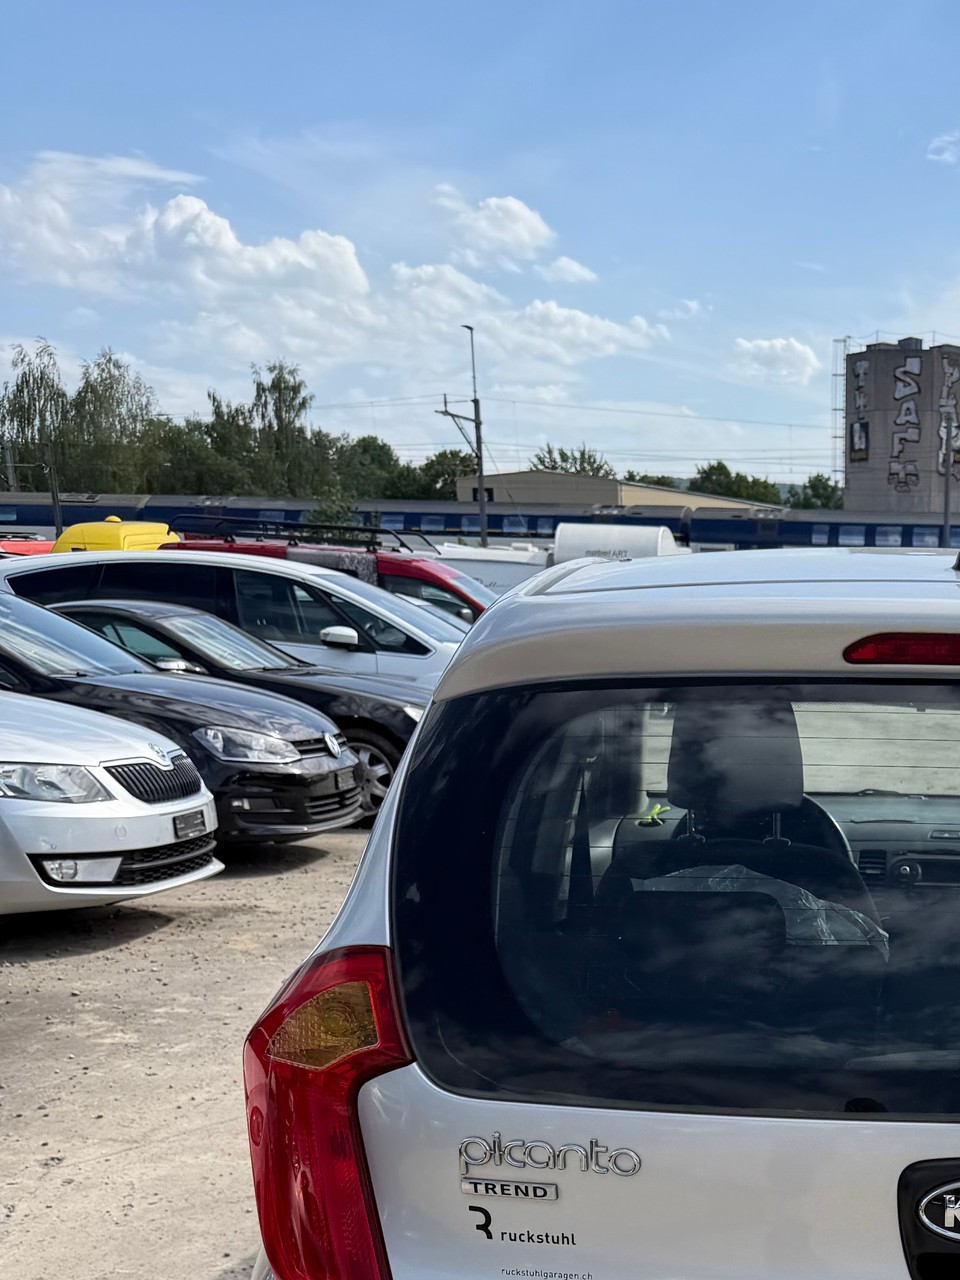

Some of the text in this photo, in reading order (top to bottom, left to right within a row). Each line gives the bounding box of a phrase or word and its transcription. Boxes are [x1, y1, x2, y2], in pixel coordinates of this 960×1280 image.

[458, 1131, 642, 1177] picanto
[469, 1181, 549, 1198] TREND
[501, 1230, 577, 1246] ruckstuhl
